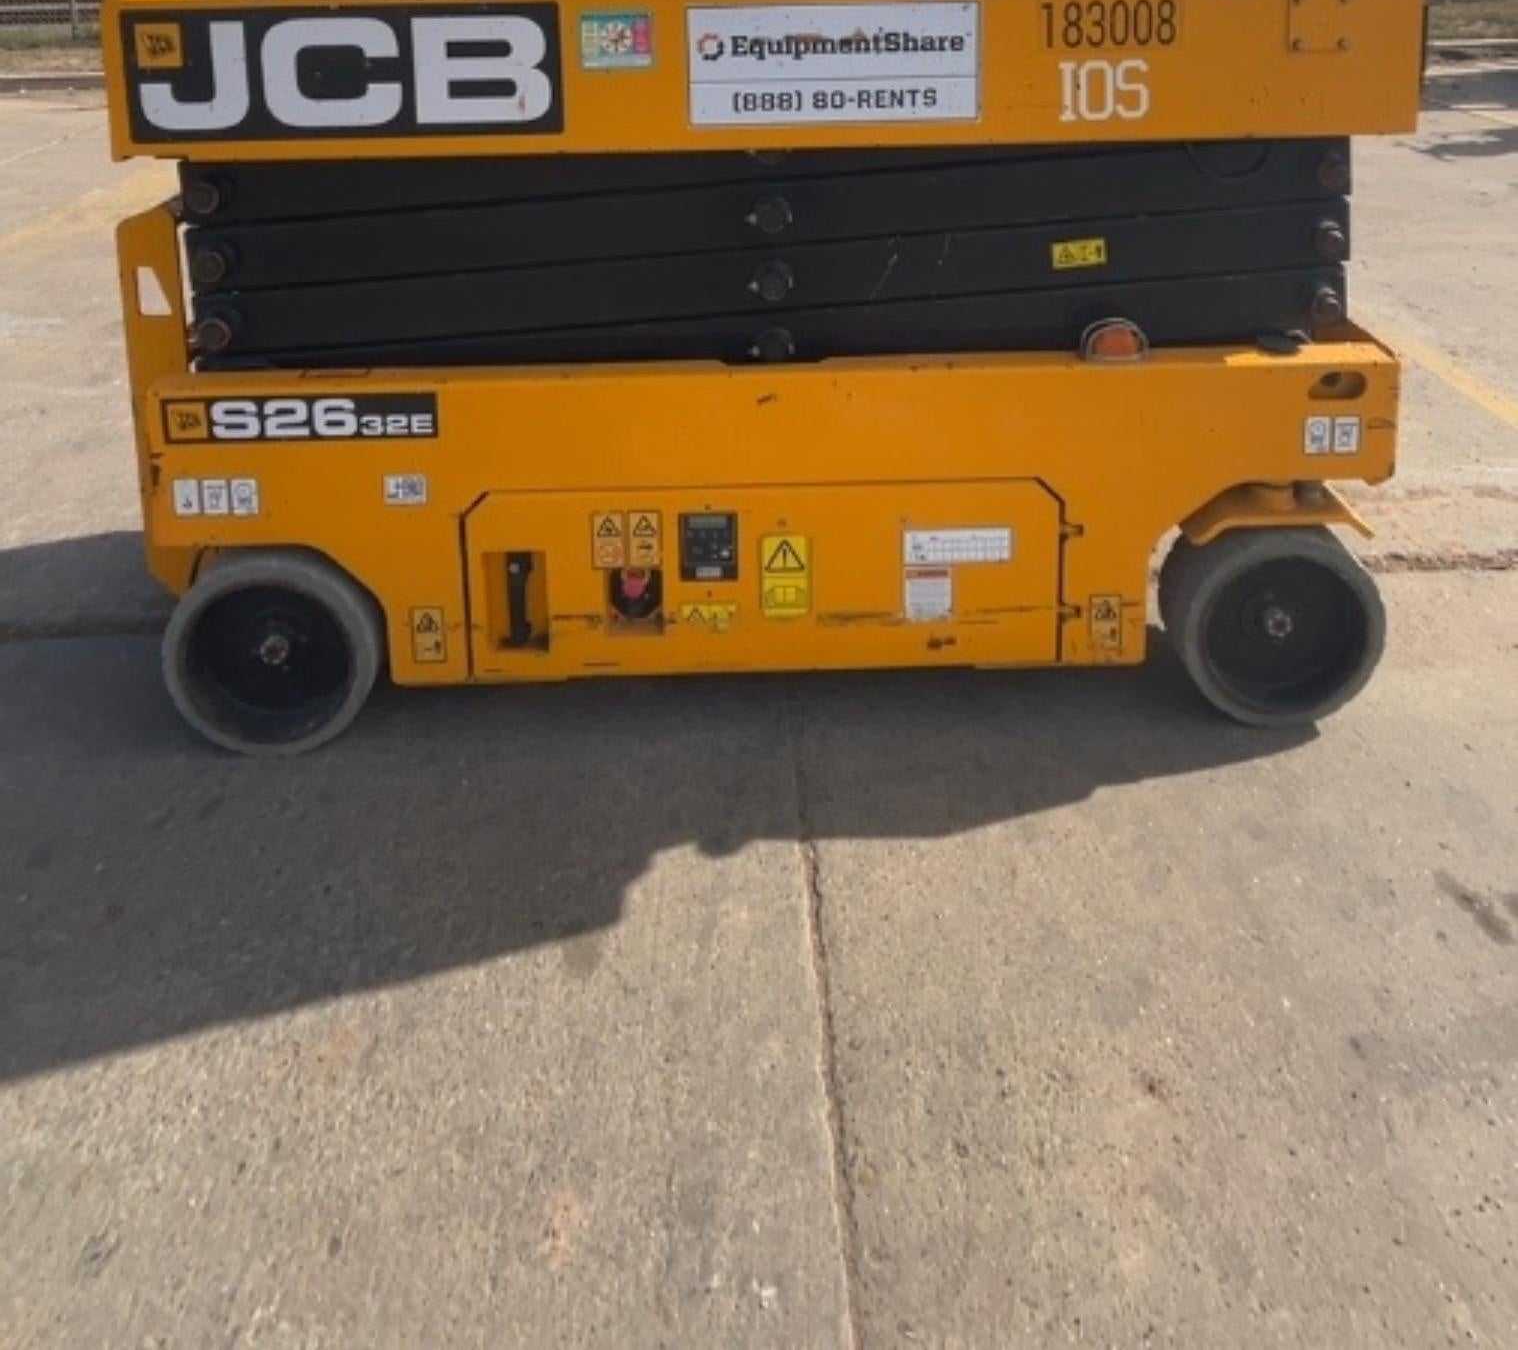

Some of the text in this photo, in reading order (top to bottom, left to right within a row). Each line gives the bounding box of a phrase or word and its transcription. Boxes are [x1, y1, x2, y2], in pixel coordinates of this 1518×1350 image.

[730, 31, 965, 61] EquipmentShare
[139, 15, 554, 132] JCB
[732, 87, 938, 113] (888) 80-RENTS
